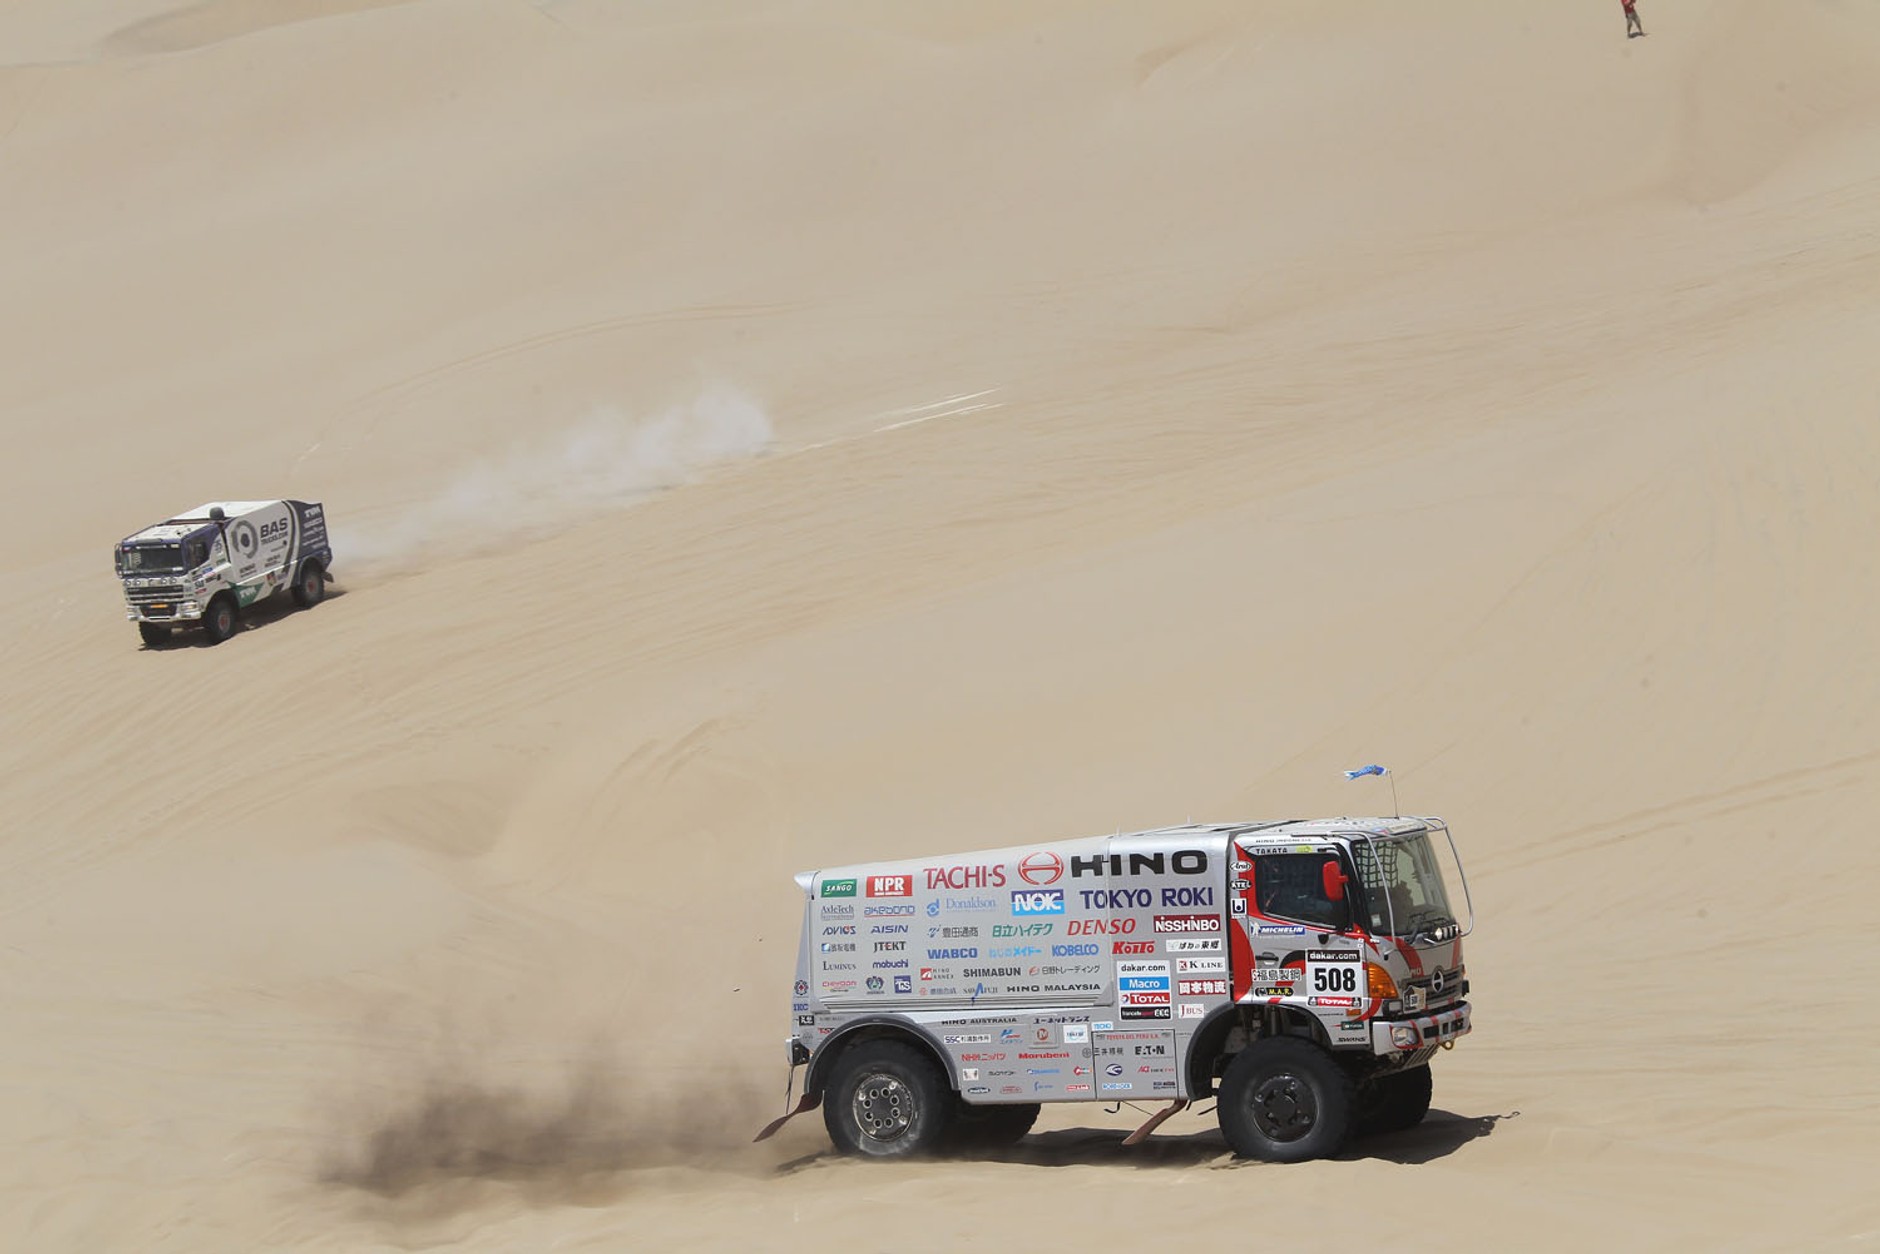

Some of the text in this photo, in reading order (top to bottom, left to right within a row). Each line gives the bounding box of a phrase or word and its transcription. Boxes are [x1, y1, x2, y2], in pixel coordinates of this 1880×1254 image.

[260, 517, 288, 538] BAS
[1070, 850, 1208, 878] HINO
[923, 864, 1007, 890] TACHI-S
[826, 884, 852, 892] SANGO
[873, 877, 905, 892] NPR
[946, 896, 996, 909] Donaldson
[1014, 892, 1062, 912] NOK
[1079, 887, 1214, 910] TOKYO ROKI
[870, 925, 908, 934] AISIN
[992, 923, 1053, 937] 日立ハイテク
[1067, 918, 1136, 936] DENSO
[1260, 925, 1304, 934] MICHELIN
[873, 941, 906, 953] JTEKT
[927, 947, 978, 959] WABCO
[1051, 943, 1099, 957] KOBELCO
[1310, 951, 1358, 960] dakar.com
[873, 960, 908, 969] mabuchi
[1121, 963, 1166, 973] dakar.com
[963, 968, 1021, 978] SHIMABUN
[1129, 979, 1160, 988] Macro
[1314, 968, 1356, 992] 508
[1044, 983, 1101, 991] MALAYSIA
[1134, 994, 1169, 1003] TOTAL
[1018, 1051, 1070, 1060] Marubeni
